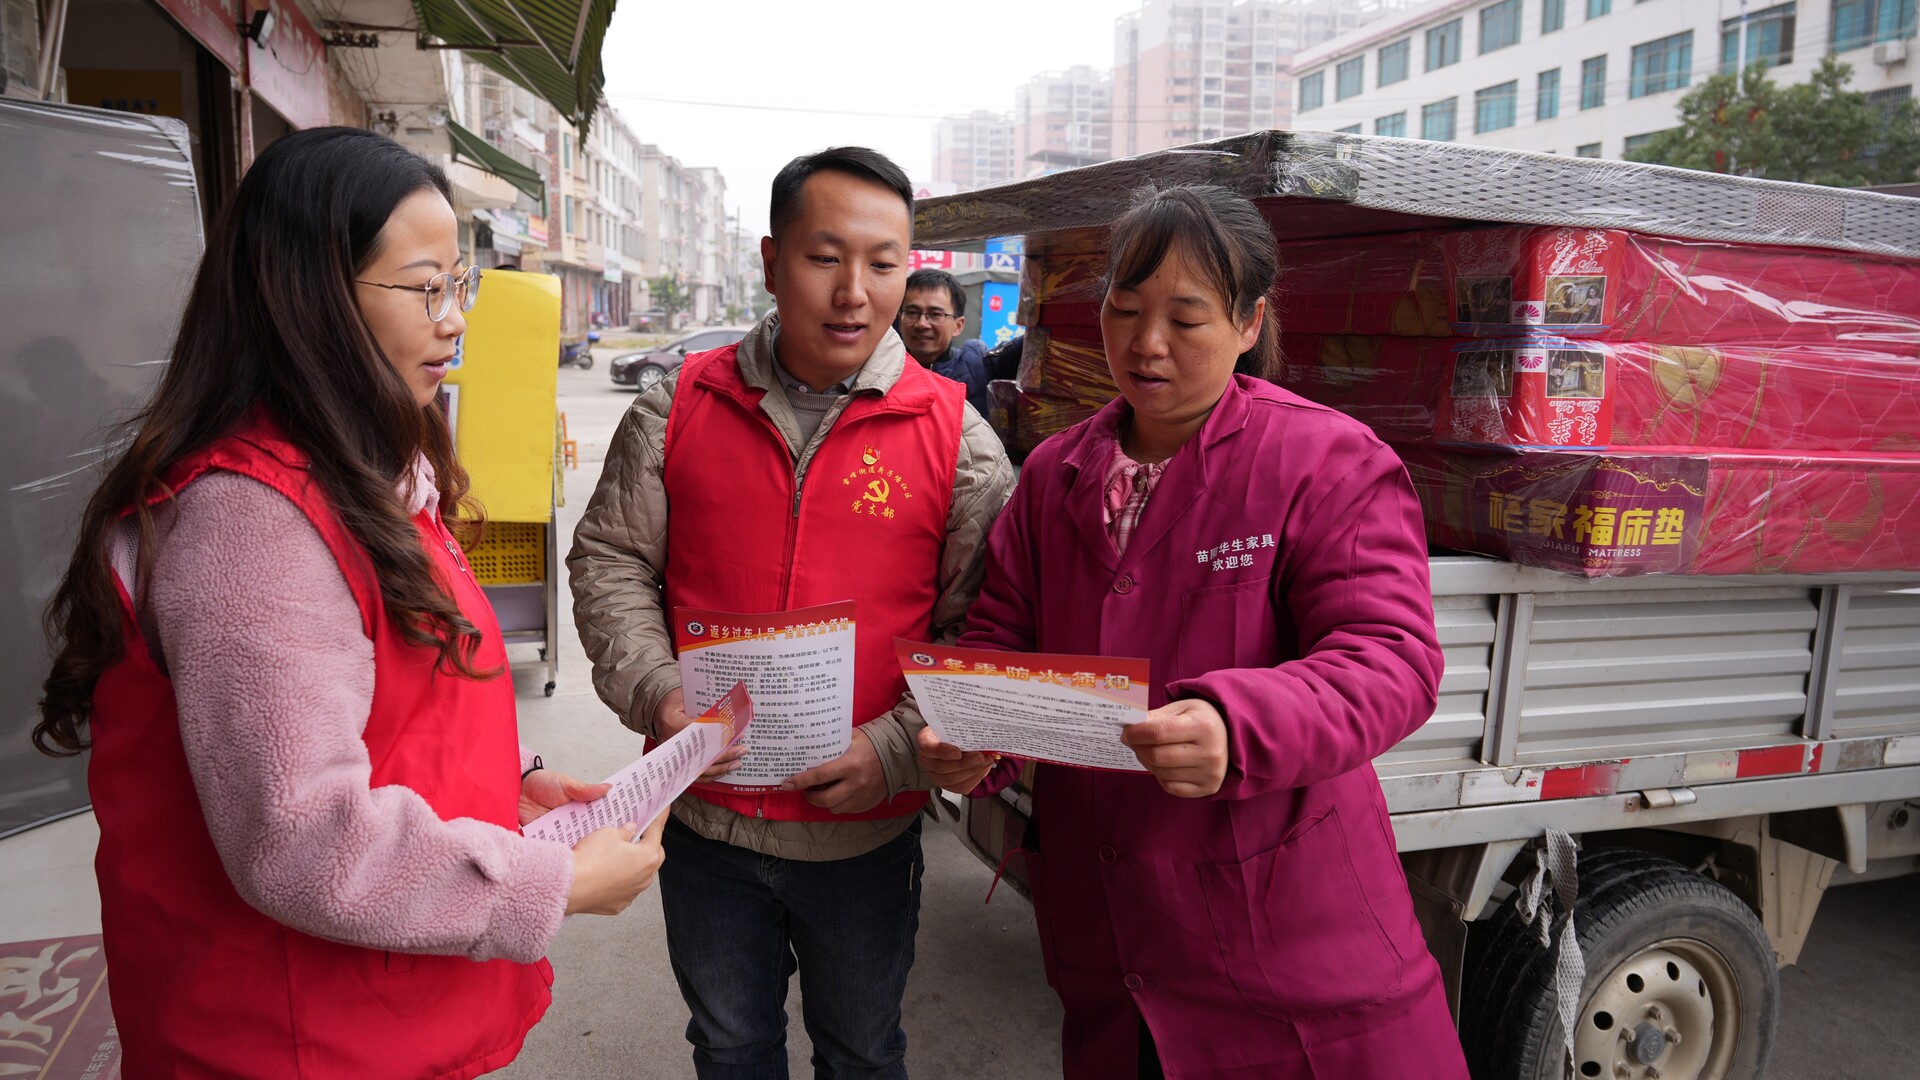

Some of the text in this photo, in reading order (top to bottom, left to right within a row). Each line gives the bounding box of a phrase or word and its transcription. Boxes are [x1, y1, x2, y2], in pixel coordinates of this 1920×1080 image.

[851, 499, 896, 521] 党支部
[1211, 552, 1254, 572] 欢迎您
[1588, 547, 1641, 559] MATTRESS
[709, 617, 850, 642] 返乡过年人员 消防安全须知
[942, 657, 1130, 691] 冬季防火须知
